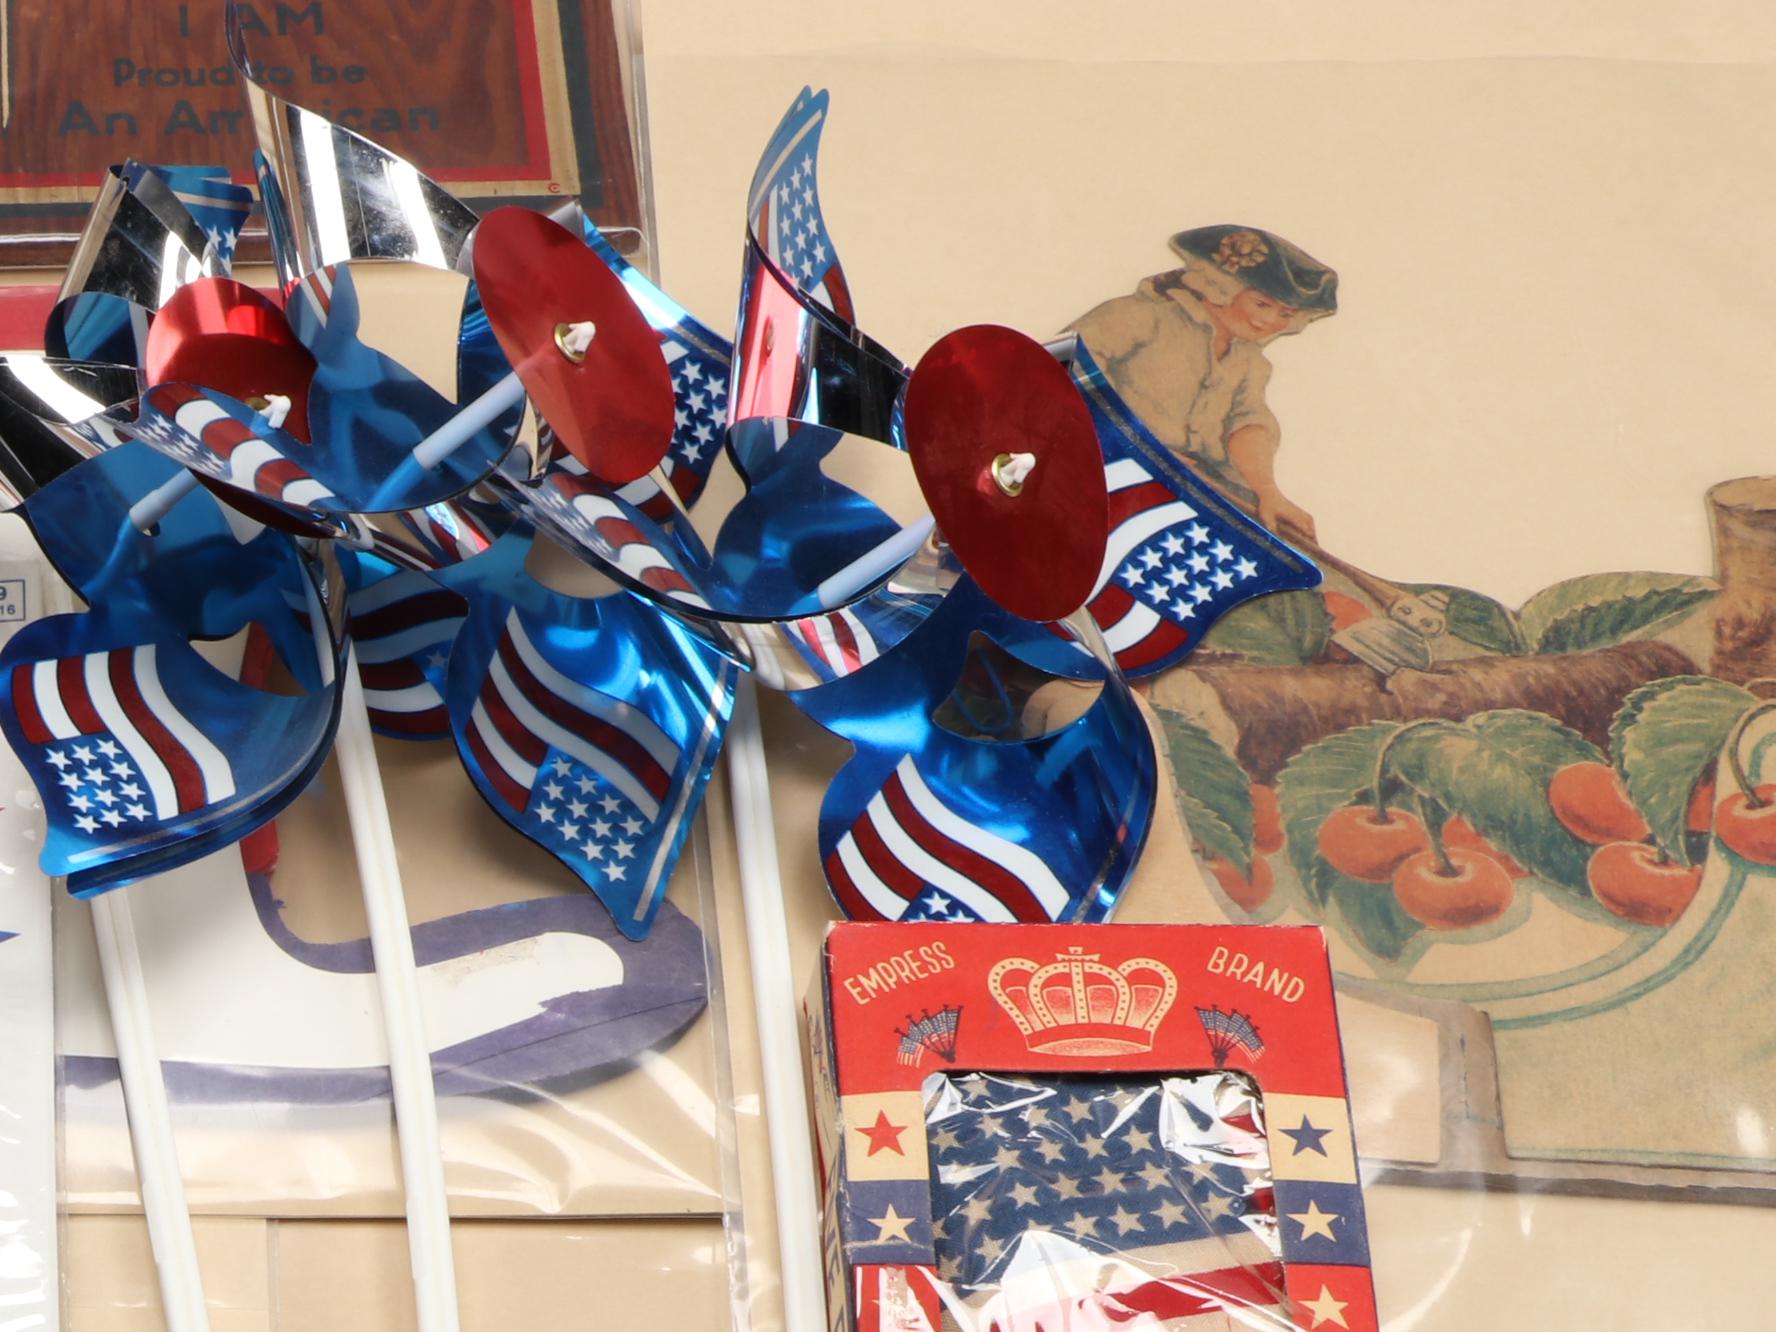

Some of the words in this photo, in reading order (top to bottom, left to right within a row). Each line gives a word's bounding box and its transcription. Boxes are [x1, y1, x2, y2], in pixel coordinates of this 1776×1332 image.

[179, 3, 190, 37] I
[238, 1, 324, 37] AM
[255, 58, 293, 86] to
[309, 55, 367, 84] be
[57, 100, 138, 137] An
[164, 99, 441, 137] Amican
[843, 940, 955, 1006] EMPRESS
[1206, 946, 1306, 1004] BRAND
